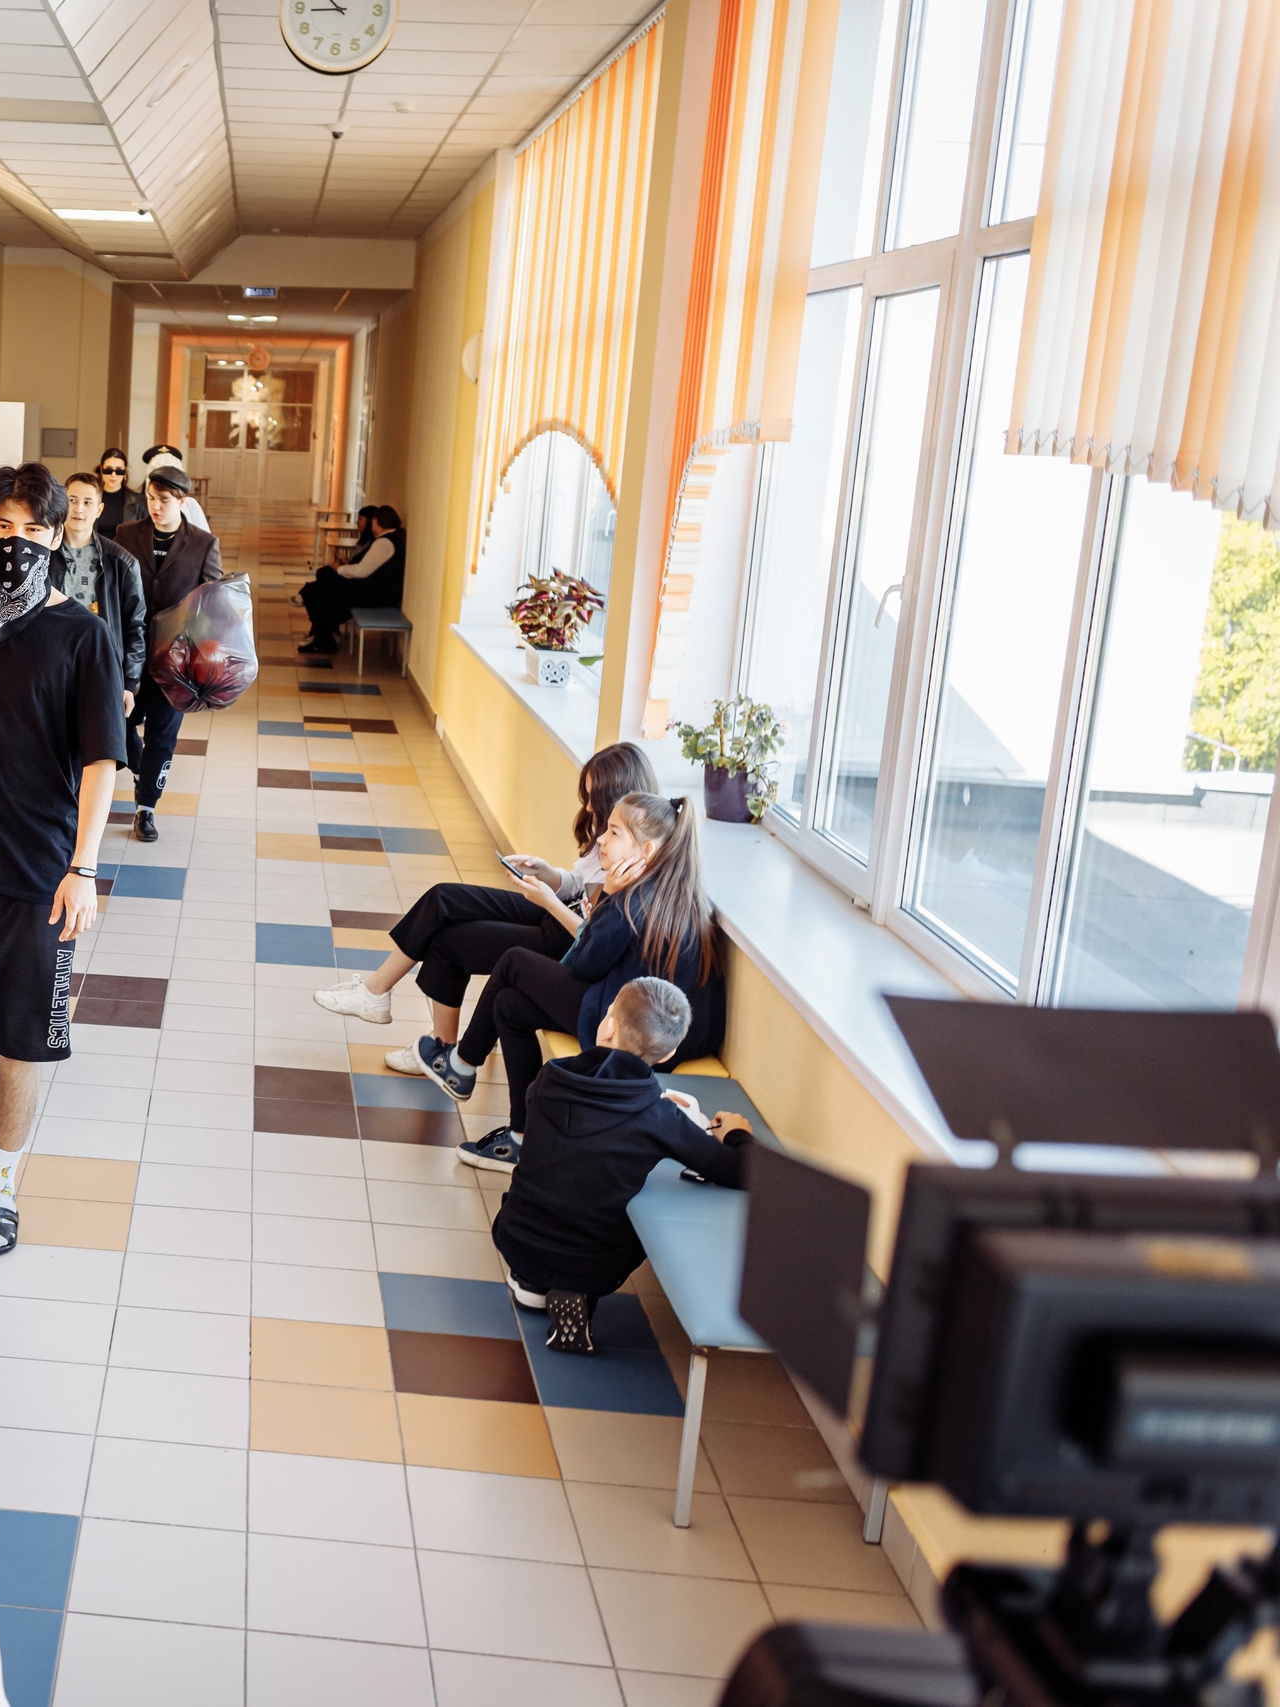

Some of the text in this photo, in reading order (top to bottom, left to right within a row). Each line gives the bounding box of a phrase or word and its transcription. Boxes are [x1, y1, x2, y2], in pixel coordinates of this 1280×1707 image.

[294, 1, 306, 15] 9
[372, 3, 384, 17] 3
[299, 21, 310, 35] 8
[364, 23, 376, 37] 4
[313, 36, 324, 50] 7
[330, 42, 341, 56] 6
[349, 38, 361, 51] 5
[47, 949, 74, 1049] ATHLETICS
